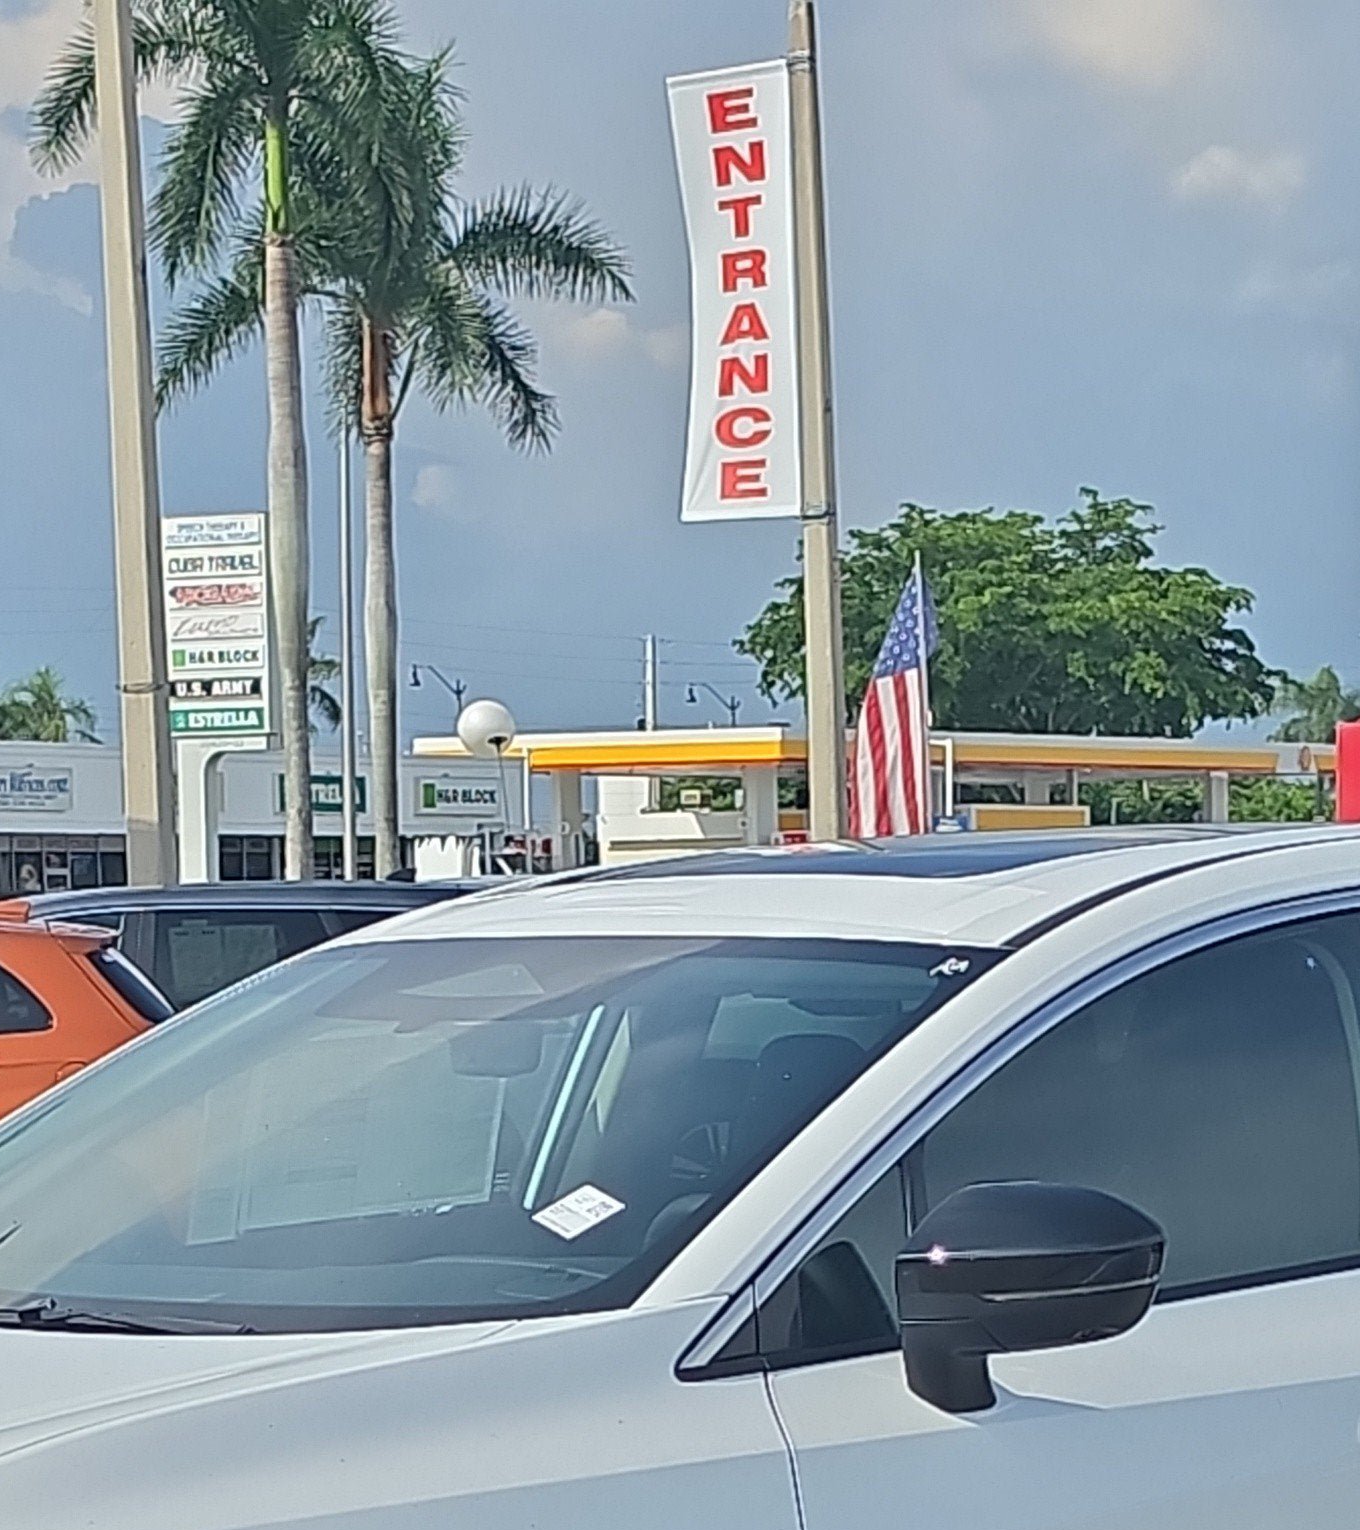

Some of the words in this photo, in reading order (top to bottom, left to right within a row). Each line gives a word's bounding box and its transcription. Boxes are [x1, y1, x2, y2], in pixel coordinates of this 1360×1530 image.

[706, 86, 771, 500] ENTRANCE
[189, 650, 215, 663] H&R
[218, 650, 259, 663] BLOCK
[174, 681, 207, 697] U.S.
[210, 679, 253, 695] ARMY
[188, 711, 259, 728] ESTRELLA
